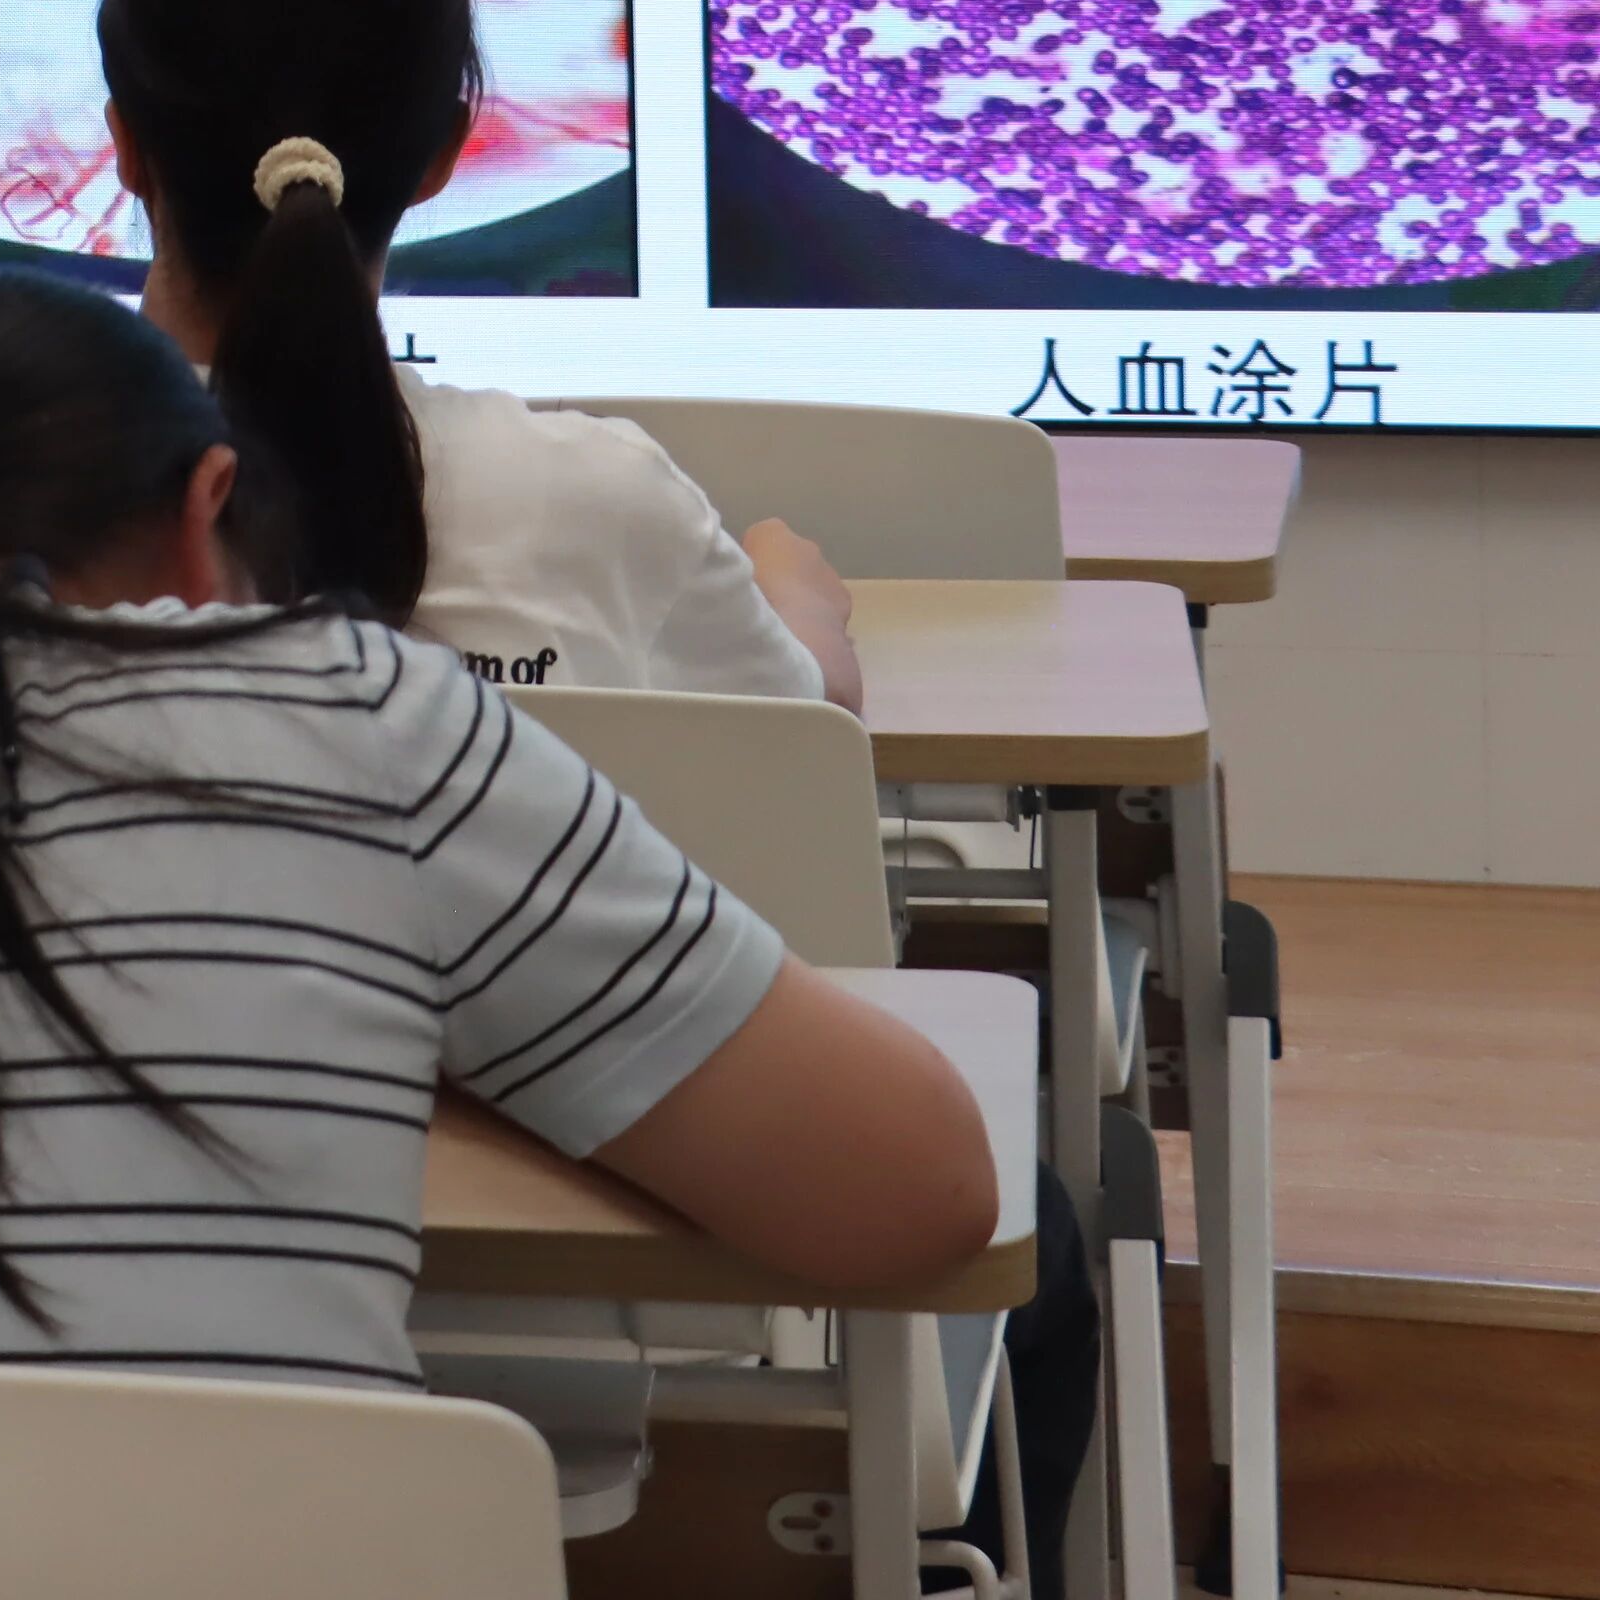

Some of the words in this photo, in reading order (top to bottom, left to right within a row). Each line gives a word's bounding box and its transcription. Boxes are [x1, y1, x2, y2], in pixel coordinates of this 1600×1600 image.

[1011, 338, 1400, 426] 人血涂片
[511, 647, 558, 684] of
